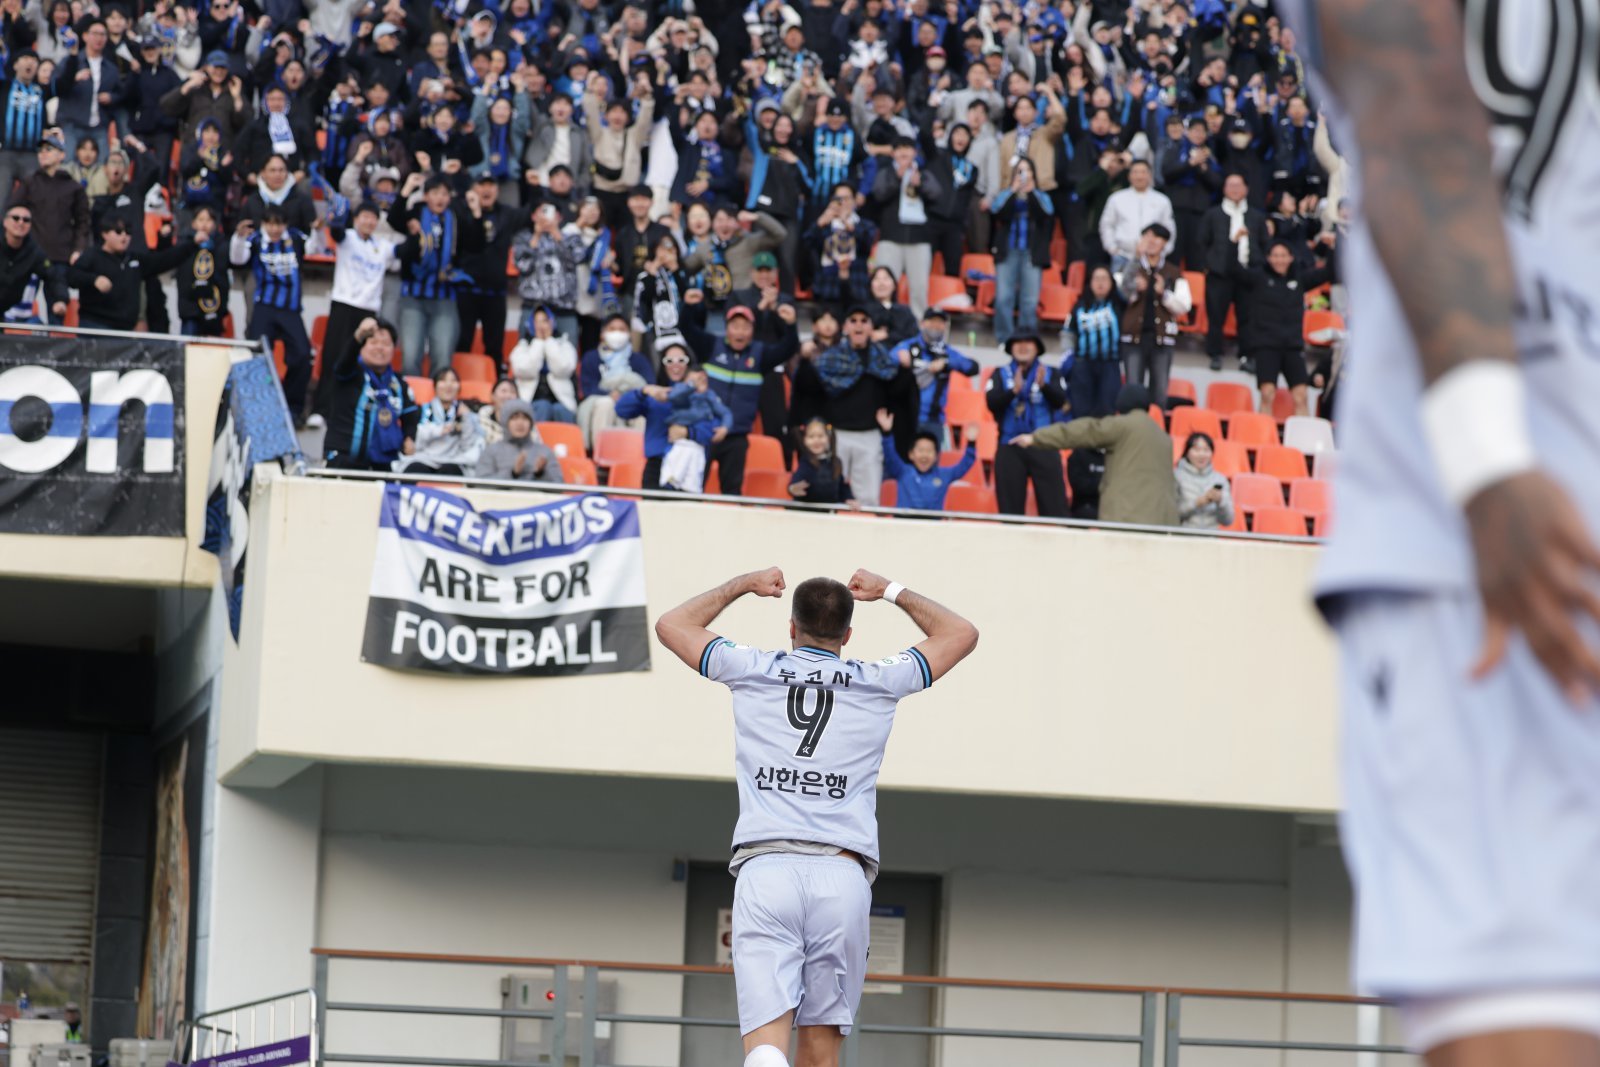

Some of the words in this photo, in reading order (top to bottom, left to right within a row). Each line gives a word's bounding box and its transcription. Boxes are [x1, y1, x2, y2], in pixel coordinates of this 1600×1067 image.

[398, 486, 615, 556] WEEKENDS
[419, 558, 502, 604] ARE
[515, 560, 592, 604] FOR
[391, 611, 618, 669] FOOTBALL
[786, 686, 834, 759] 9
[754, 766, 848, 799] 신한은행
